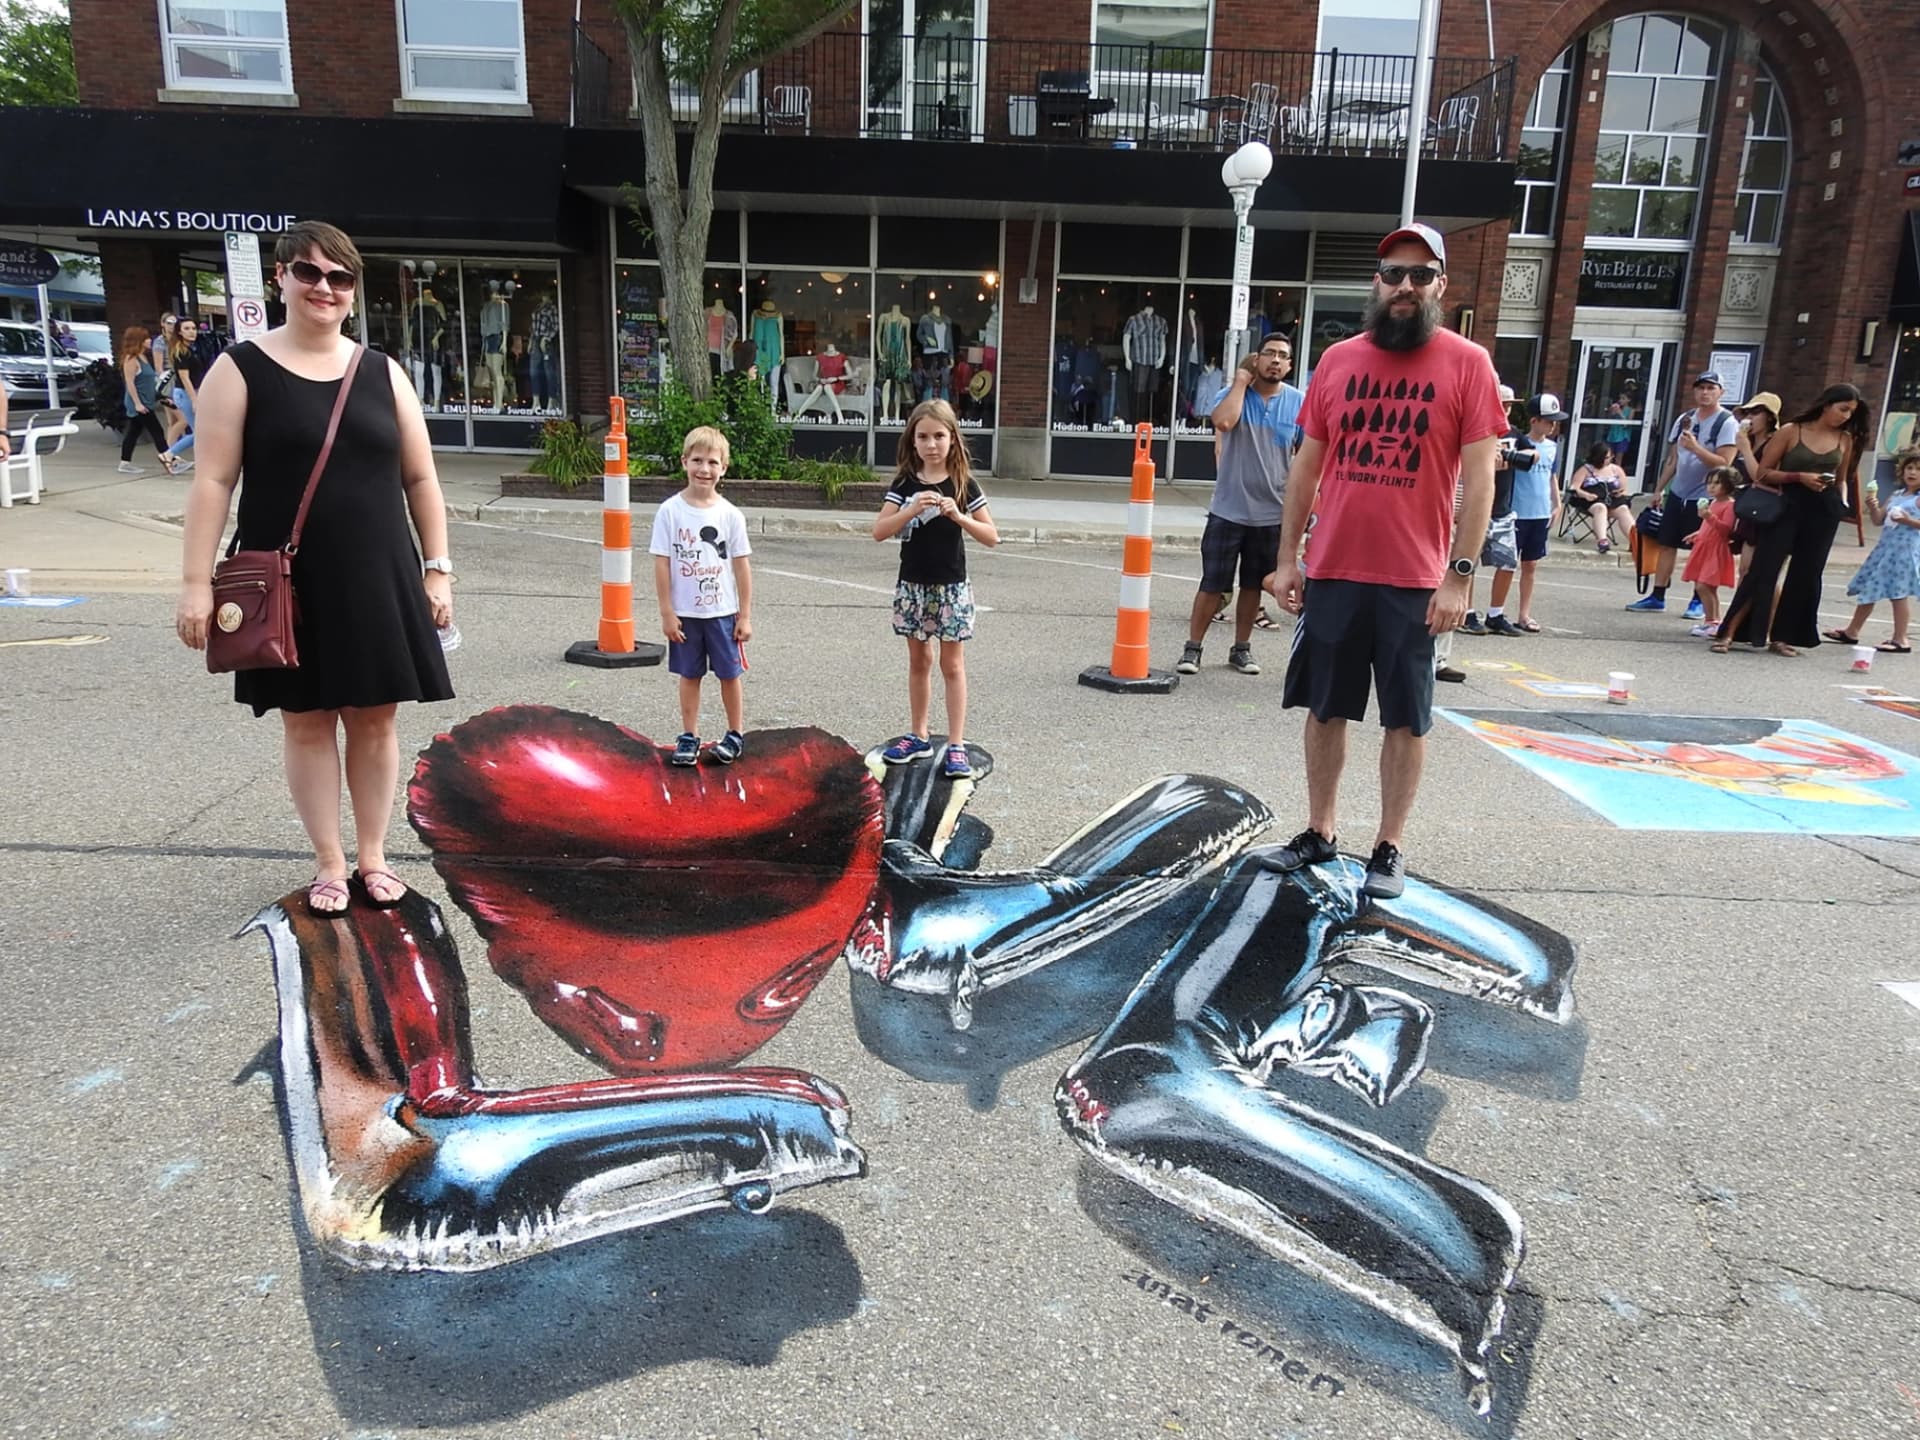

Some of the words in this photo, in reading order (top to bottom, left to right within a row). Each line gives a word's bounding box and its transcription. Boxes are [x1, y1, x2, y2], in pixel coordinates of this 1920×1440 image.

[87, 208, 171, 230] LANA'S
[229, 235, 238, 249] 2
[0, 250, 38, 264] ana's
[1597, 351, 1643, 370] 518
[1052, 422, 1088, 432] Hudson
[1175, 418, 1213, 435] Wooden
[1347, 471, 1378, 485] WORN
[1379, 474, 1417, 489] FLINTS
